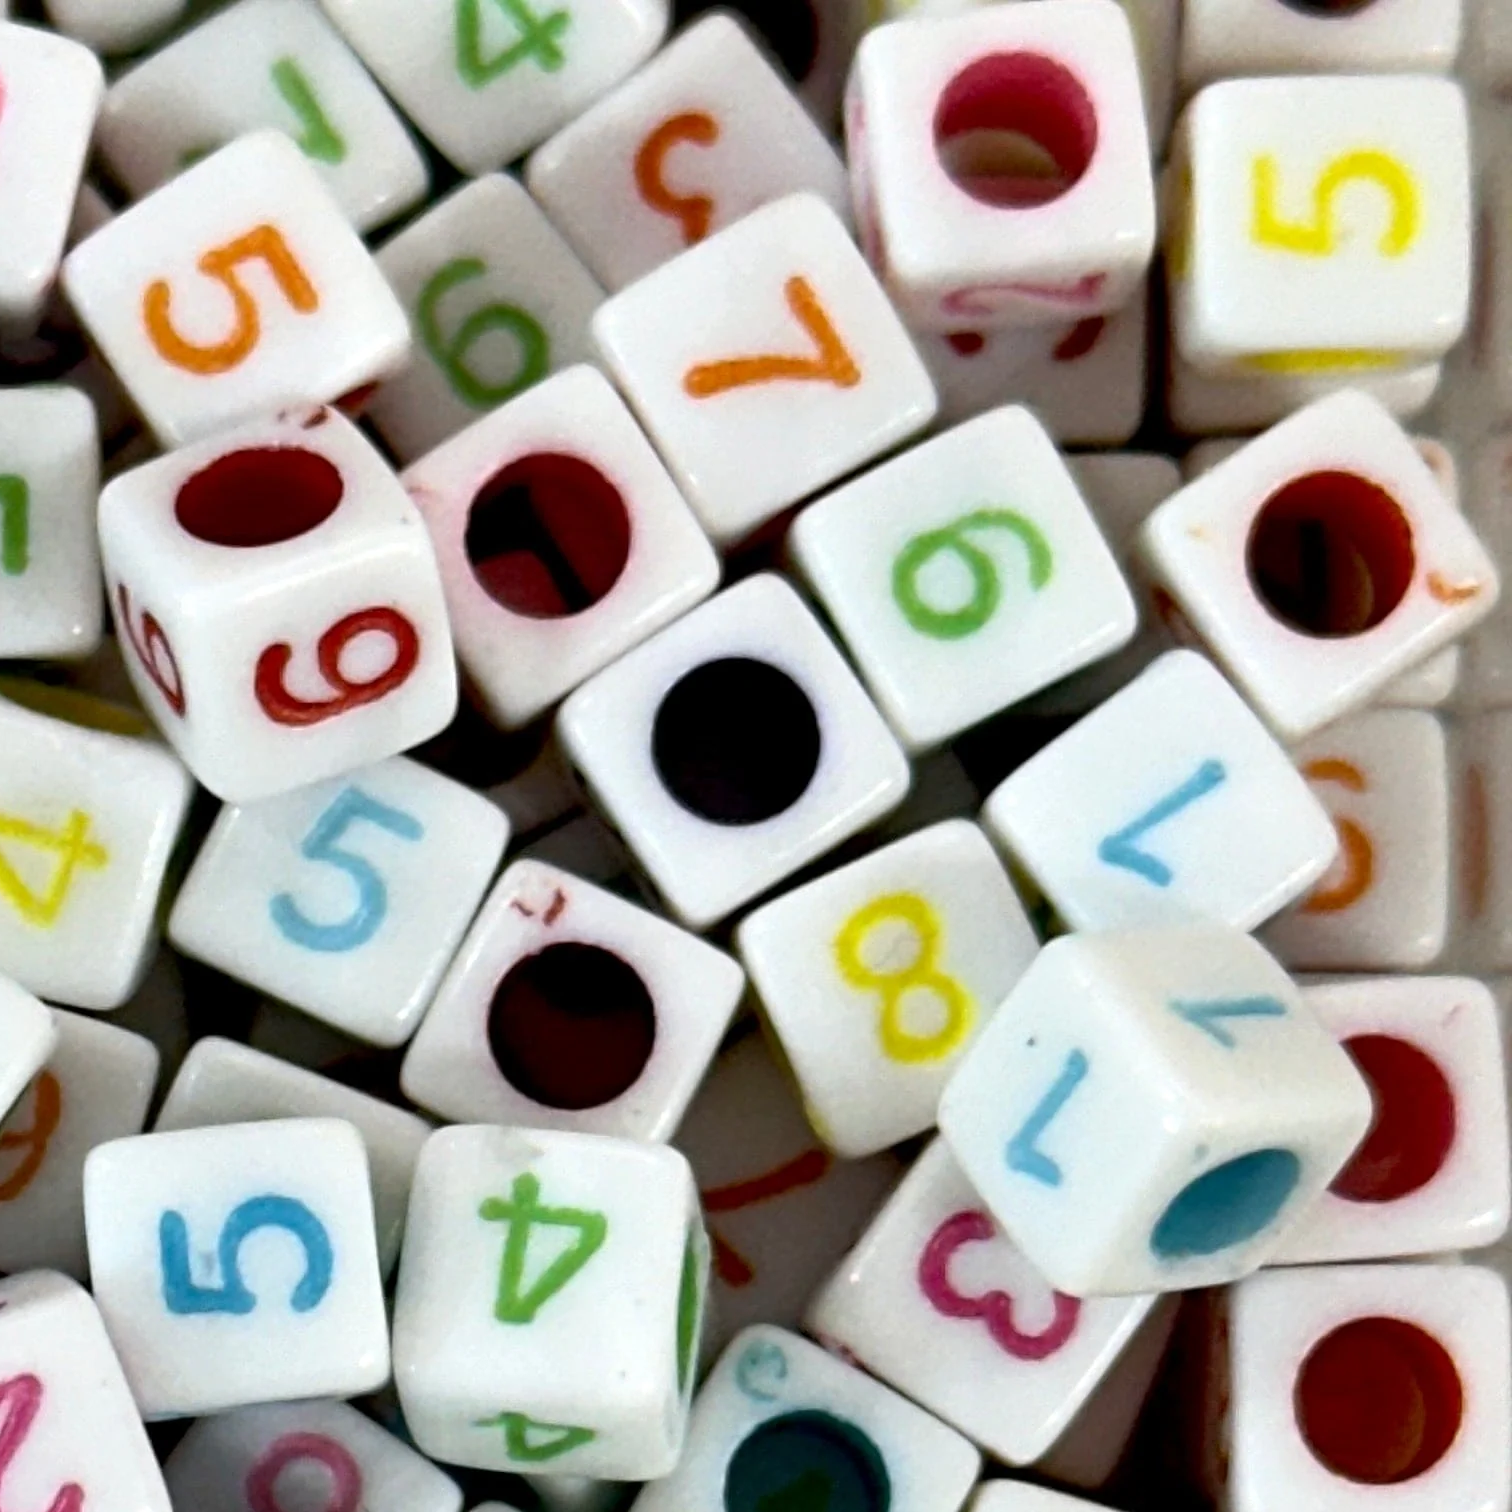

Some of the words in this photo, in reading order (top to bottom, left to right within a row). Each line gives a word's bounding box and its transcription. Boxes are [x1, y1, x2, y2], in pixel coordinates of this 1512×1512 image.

[454, 0, 571, 88] 4
[1248, 146, 1425, 259] 5
[144, 225, 318, 373] 5
[686, 278, 859, 396] 7
[269, 785, 424, 953] 5
[832, 891, 978, 1066] 8
[163, 1199, 330, 1310] 5
[482, 1174, 607, 1322] 4
[922, 1213, 1077, 1357] 3
